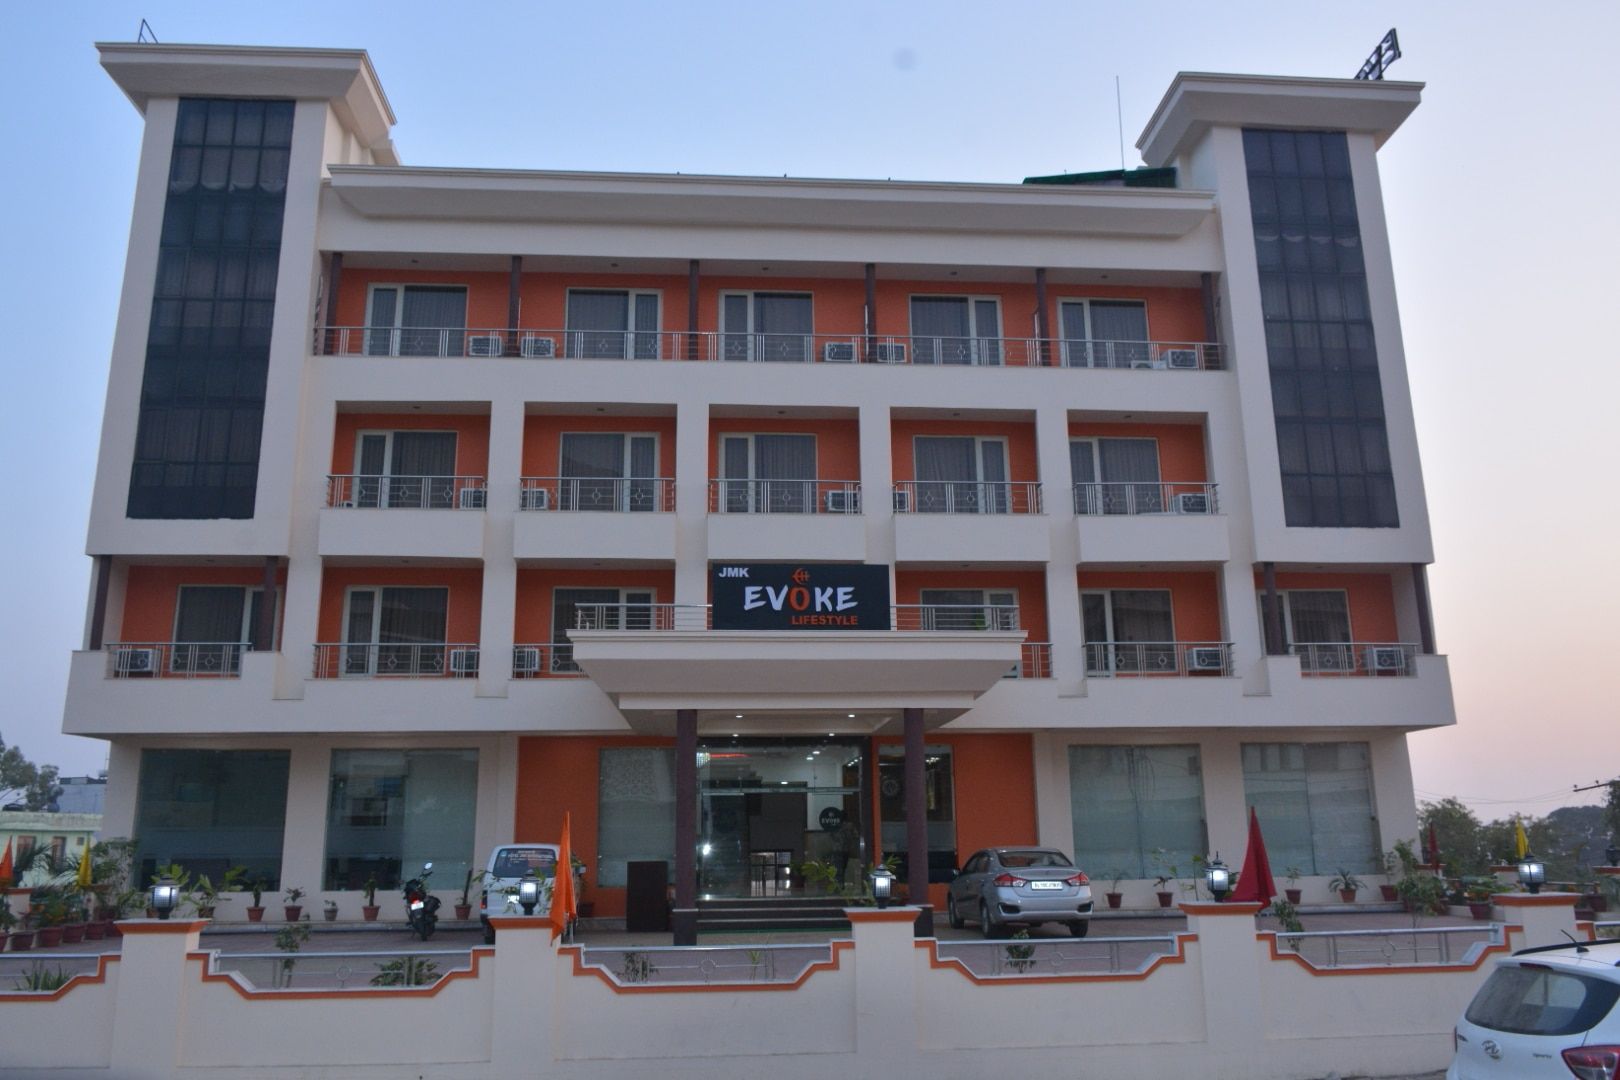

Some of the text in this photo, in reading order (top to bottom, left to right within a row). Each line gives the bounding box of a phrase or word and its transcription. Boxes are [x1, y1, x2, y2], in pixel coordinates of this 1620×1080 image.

[719, 567, 750, 578] JMK
[744, 585, 858, 612] EVOKE
[792, 615, 858, 625] LIFESTYLE
